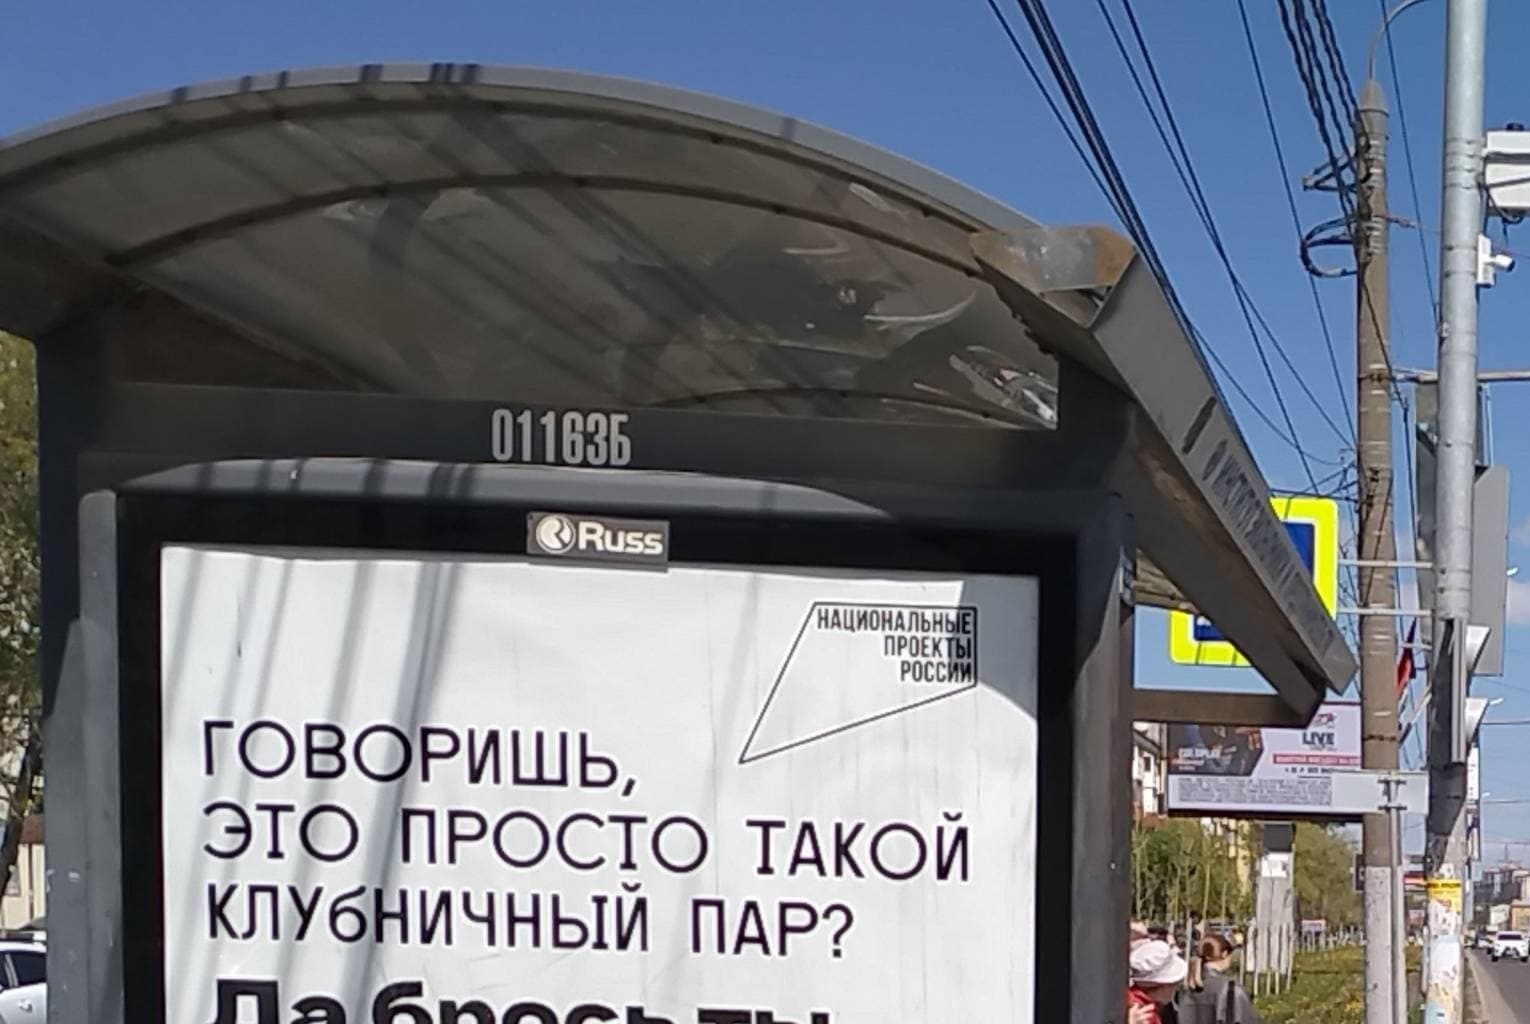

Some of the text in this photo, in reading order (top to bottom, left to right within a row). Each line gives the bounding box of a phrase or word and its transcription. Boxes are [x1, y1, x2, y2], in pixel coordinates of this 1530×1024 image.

[491, 408, 632, 466] 01163Б
[577, 520, 664, 555] Russ
[817, 607, 972, 634] НАЦИОНАЛЬНЫЕ
[884, 635, 972, 659] ПРОЕКТЫ
[901, 660, 972, 683] РОССИИ
[1302, 731, 1335, 746] LIVE
[203, 722, 638, 797] ГОВОРИШЬ,
[203, 804, 971, 882] ЭТО ПРОСТО ТАКОЙ
[691, 899, 855, 959] ПАР?
